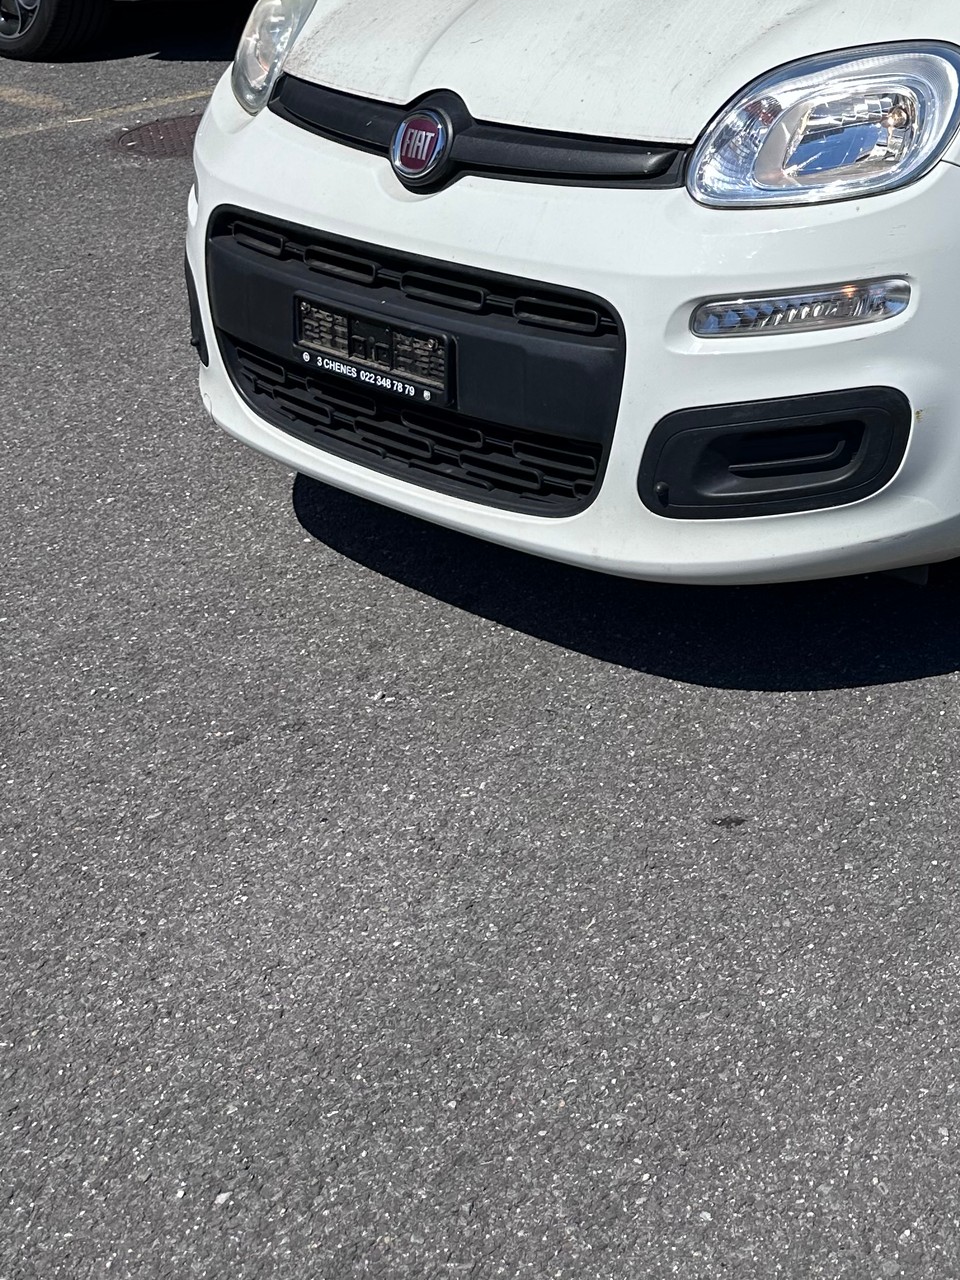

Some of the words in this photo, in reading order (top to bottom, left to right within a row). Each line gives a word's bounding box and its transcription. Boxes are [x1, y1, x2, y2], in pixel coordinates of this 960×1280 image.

[401, 128, 436, 161] FIAT
[317, 356, 323, 367] 3
[323, 359, 357, 378] CHENES
[360, 370, 375, 384] 022
[376, 375, 391, 389] 348
[392, 380, 403, 393] 78
[404, 384, 415, 397] 79
